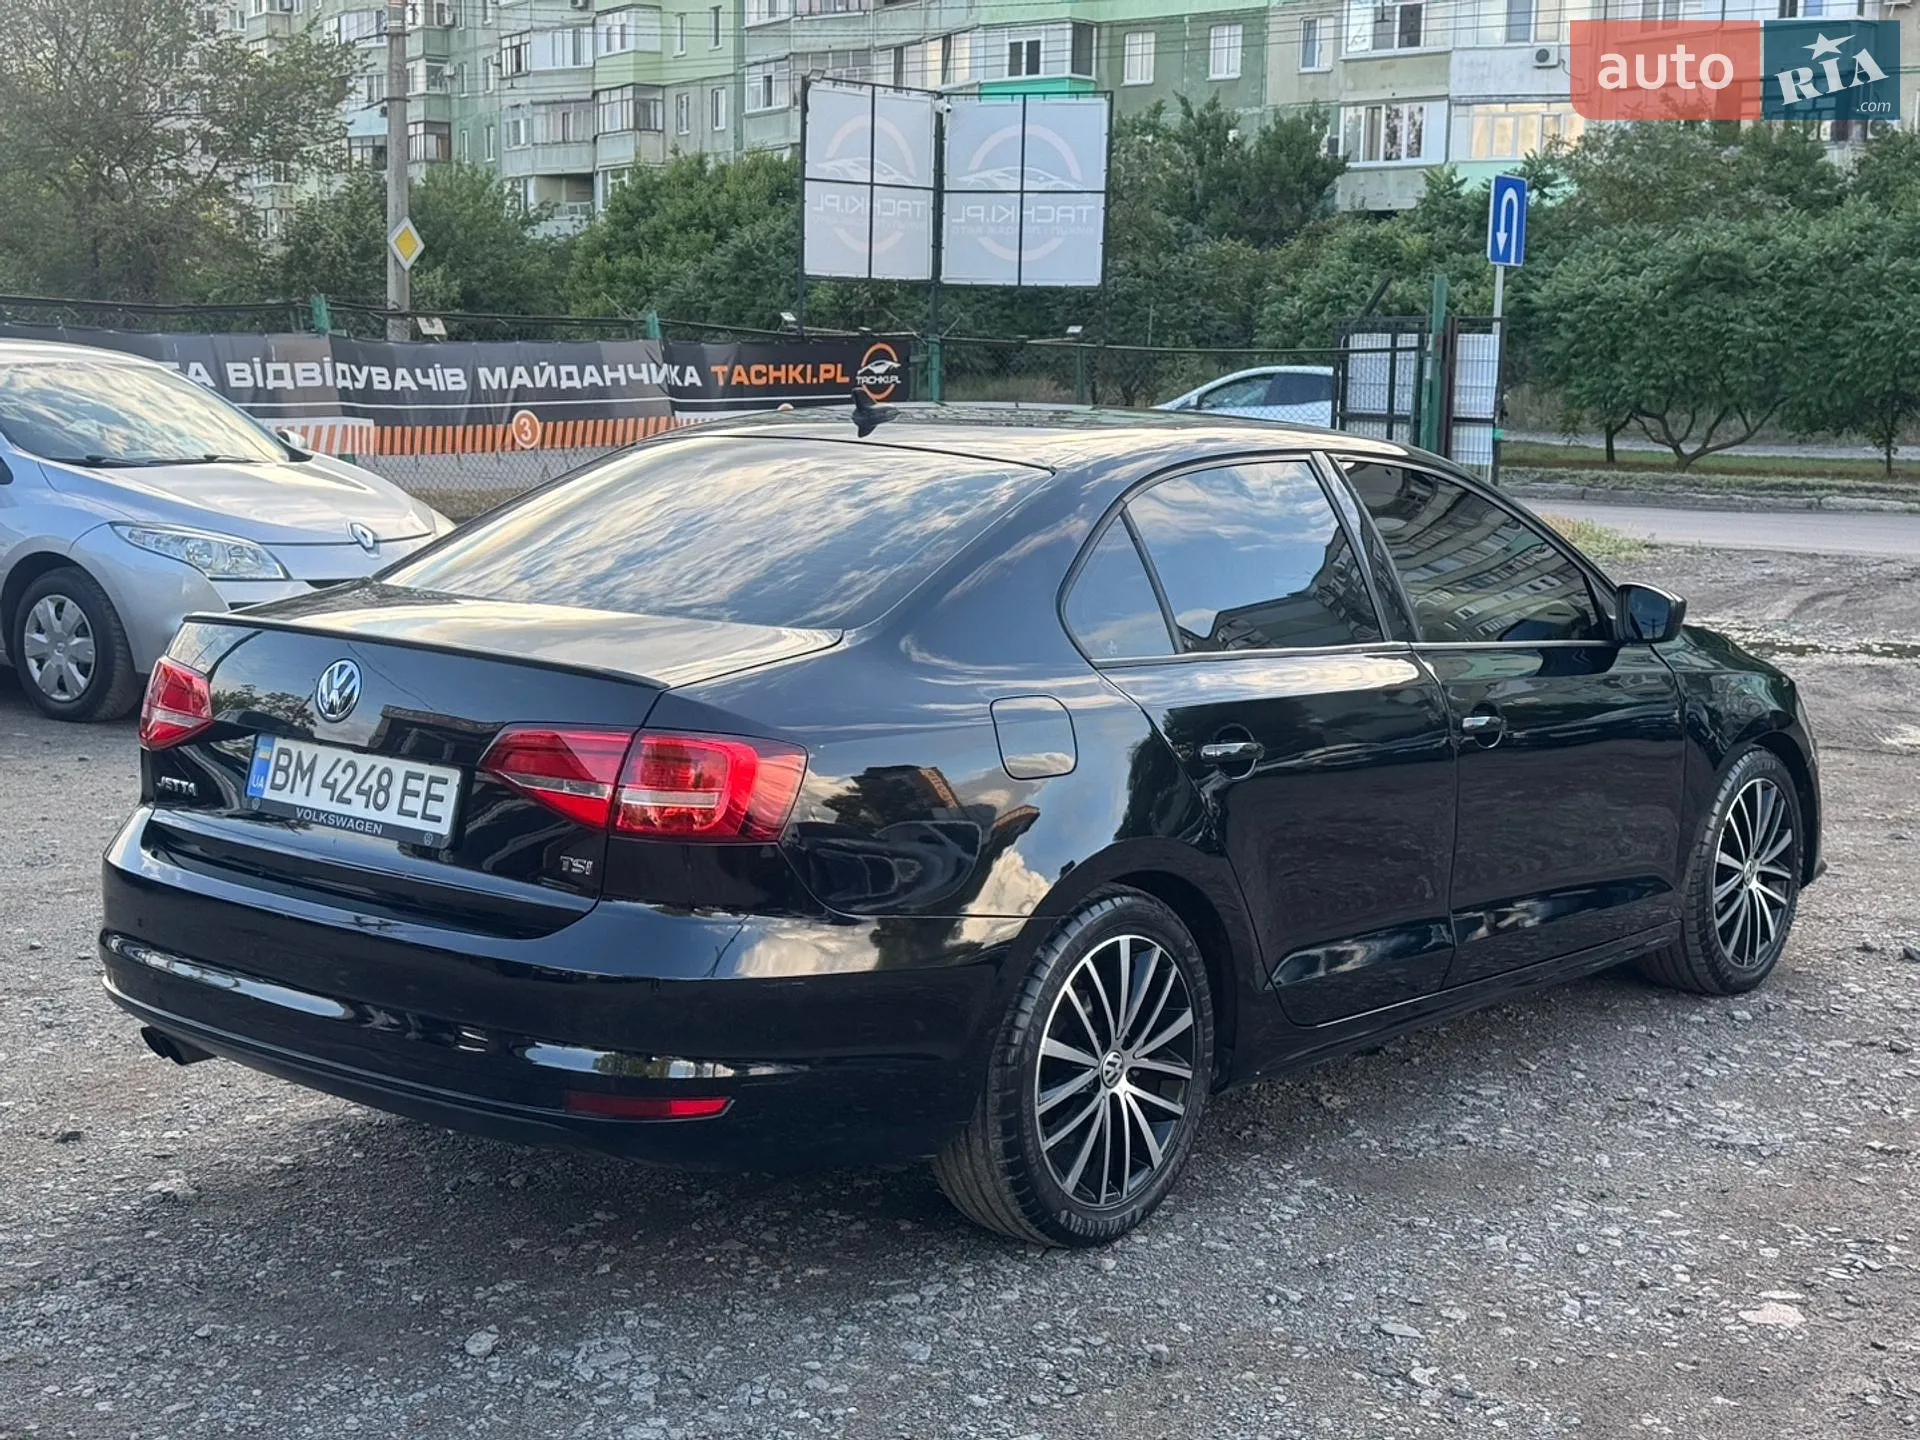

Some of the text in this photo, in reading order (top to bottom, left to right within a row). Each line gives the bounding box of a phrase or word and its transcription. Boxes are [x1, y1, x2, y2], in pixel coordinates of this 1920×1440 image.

[477, 362, 703, 390] МАЙДАНЧИКА
[710, 363, 850, 387] TACHKI.PL
[520, 416, 532, 441] 3
[252, 747, 449, 824] UA BM 4248 EE
[295, 807, 383, 835] VOLKSWAGEN
[560, 855, 593, 875] TSI
